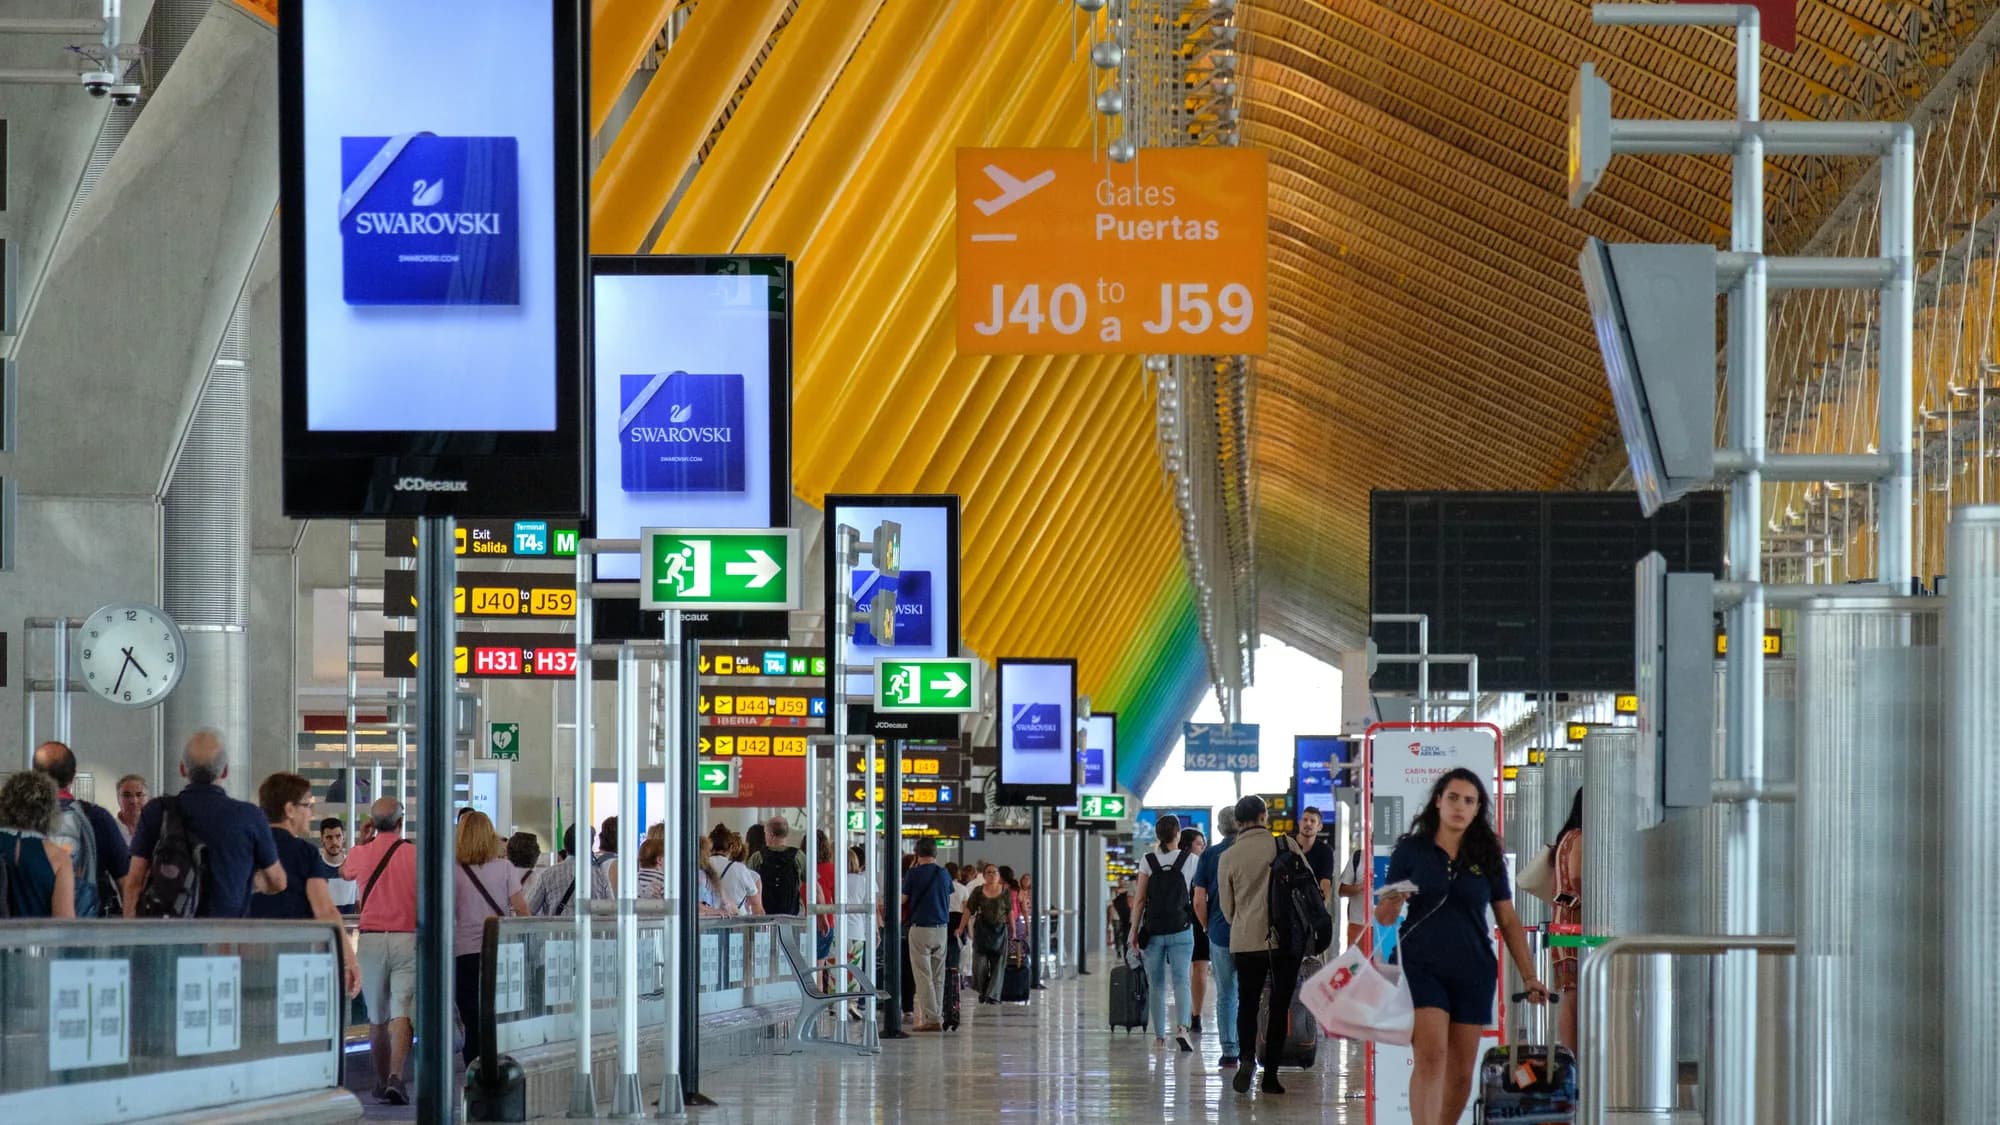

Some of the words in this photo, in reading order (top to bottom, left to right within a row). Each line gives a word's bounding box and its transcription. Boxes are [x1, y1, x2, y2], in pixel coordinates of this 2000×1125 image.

[1095, 178, 1176, 207] Gates
[355, 212, 500, 236] SWAROVSKI
[1095, 213, 1219, 241] Puertas
[1096, 277, 1125, 304] to
[973, 282, 1087, 336] J40
[1142, 282, 1254, 335] J59
[1099, 316, 1122, 342] a
[631, 427, 732, 443] SWAROVSKI
[393, 477, 467, 492] JCDecaux
[472, 529, 491, 539] Exit
[472, 541, 507, 554] Salida
[557, 533, 575, 552] M
[477, 592, 515, 610] J40
[536, 593, 572, 611] J59
[520, 590, 530, 600] to
[125, 610, 137, 621] 12
[521, 605, 528, 613] a
[657, 612, 709, 622] Jecaux
[83, 648, 92, 660] 9
[166, 652, 175, 663] 3
[523, 650, 533, 660] to
[477, 651, 518, 670] H31
[537, 652, 576, 671] H37
[792, 660, 805, 672] M
[524, 664, 532, 673] a
[123, 690, 132, 701] 6
[739, 699, 764, 712] J44
[779, 700, 804, 713] J59
[814, 701, 824, 714] K
[717, 716, 757, 725] IBERIA
[741, 740, 766, 752] J42
[777, 740, 803, 753] J43
[1186, 753, 1217, 769] K62
